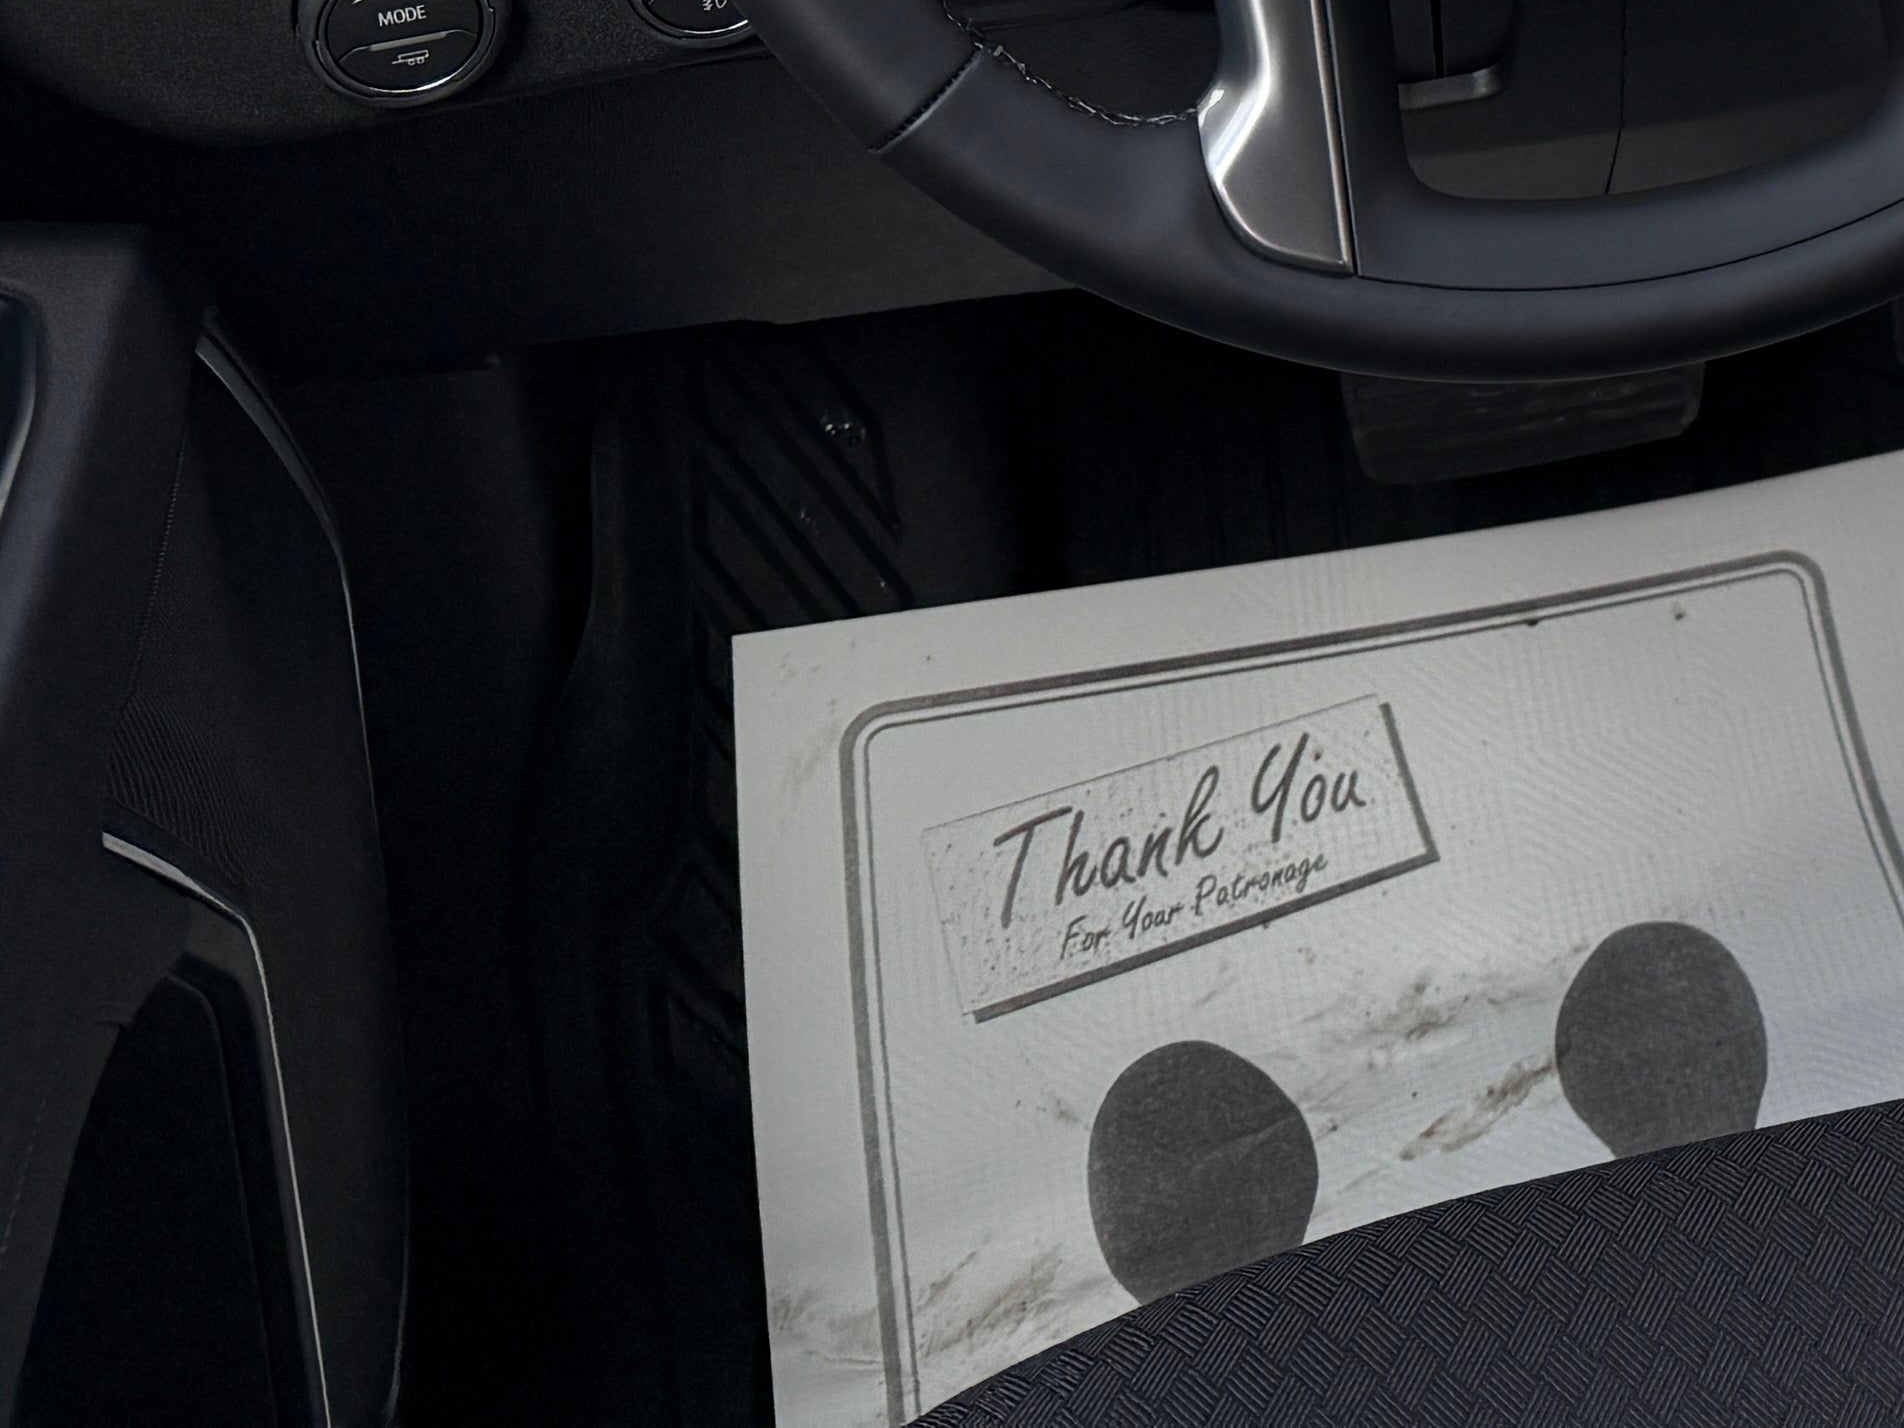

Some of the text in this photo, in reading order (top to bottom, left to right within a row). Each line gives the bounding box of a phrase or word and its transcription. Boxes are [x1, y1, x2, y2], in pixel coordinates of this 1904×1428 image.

[377, 4, 428, 28] MODE
[993, 731, 1366, 929] Thank You
[1060, 852, 1328, 959] For Your Patronage
